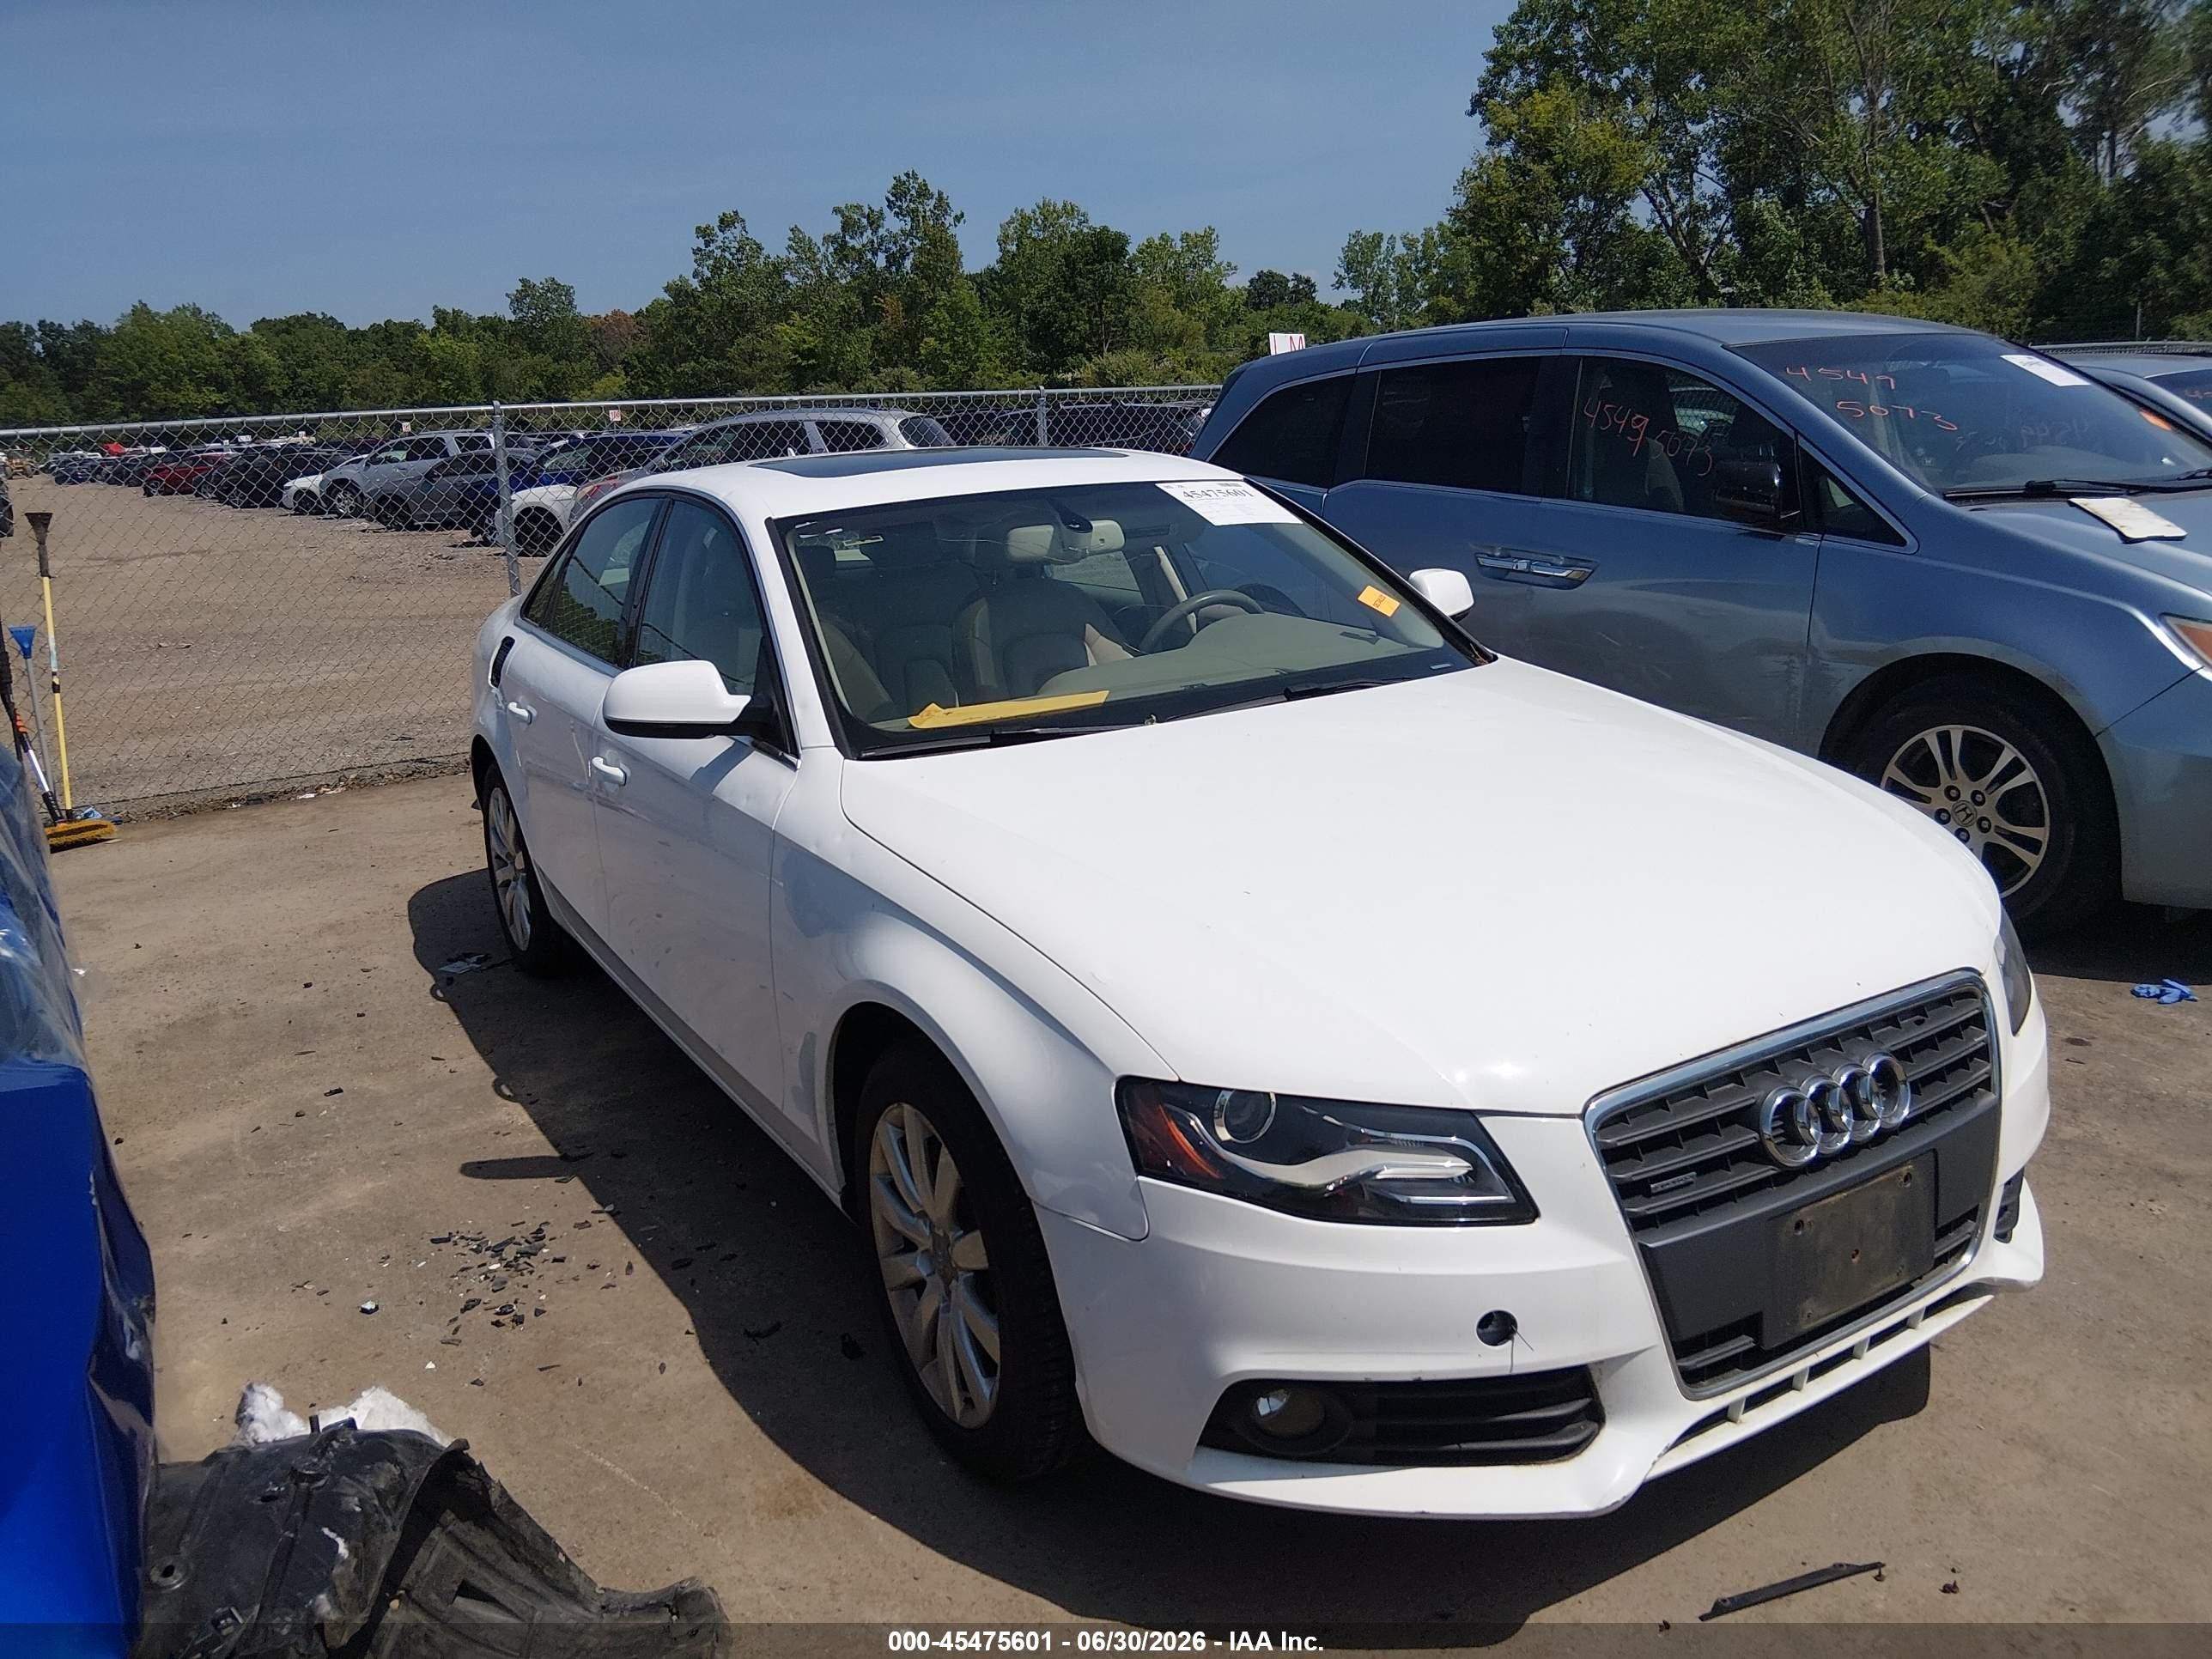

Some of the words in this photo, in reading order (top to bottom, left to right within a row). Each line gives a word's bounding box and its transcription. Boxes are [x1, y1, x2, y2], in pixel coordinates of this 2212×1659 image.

[1785, 365, 1897, 391] 4549
[1835, 400, 1959, 431] 5073
[1583, 397, 1650, 458] 4549
[1650, 429, 1713, 477] 5073
[1182, 489, 1255, 499] 45475601
